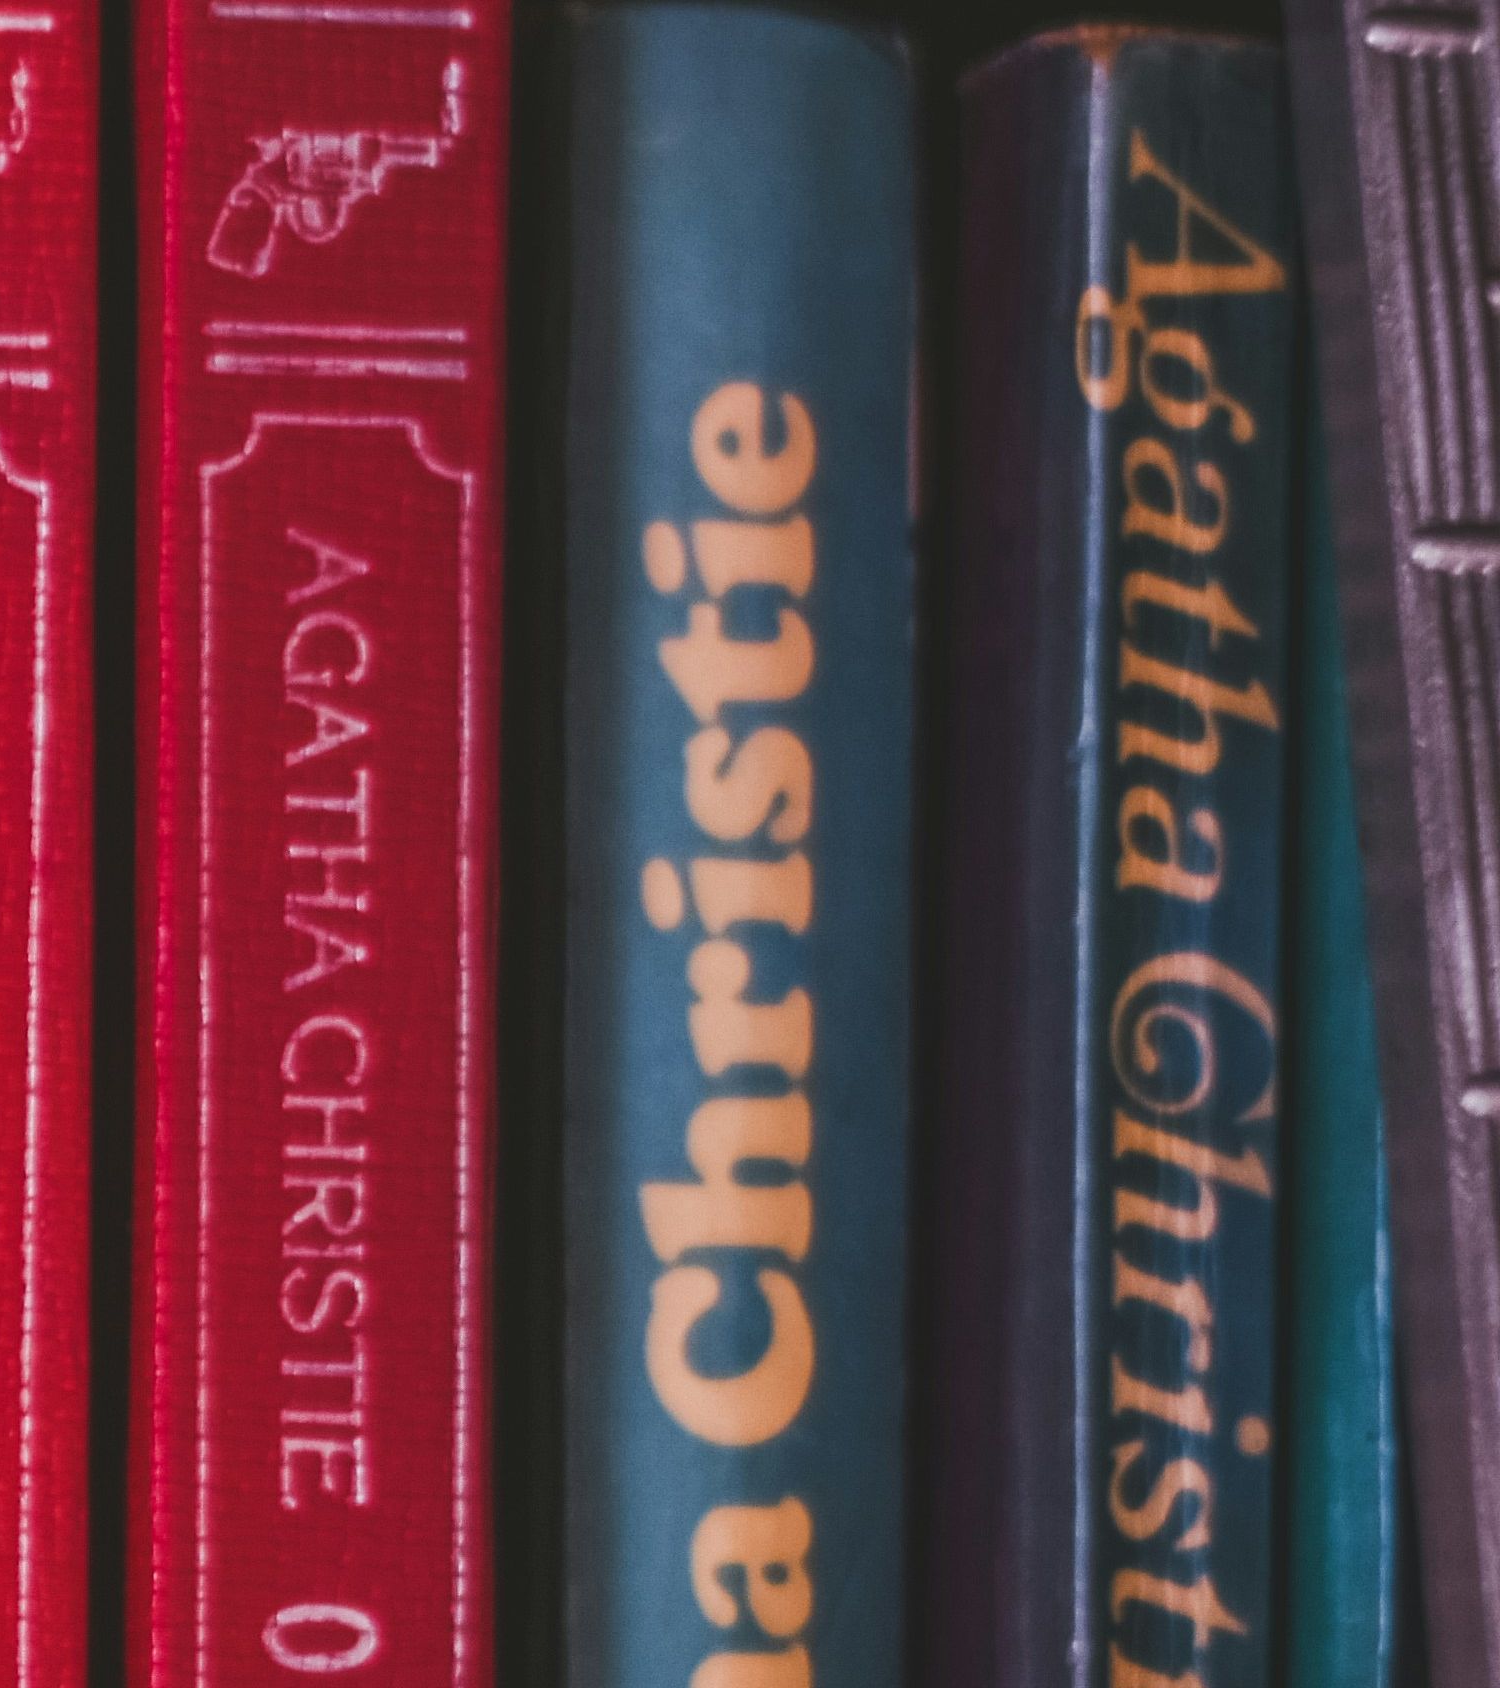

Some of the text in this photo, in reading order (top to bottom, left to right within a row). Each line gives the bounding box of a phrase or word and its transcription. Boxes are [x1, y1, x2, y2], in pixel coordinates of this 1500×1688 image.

[282, 527, 370, 993] AGATHA
[1075, 126, 1288, 904] Agatha
[641, 380, 819, 1448] Christie
[280, 1016, 371, 1514] CHRISTIE
[261, 1602, 378, 1672] O
